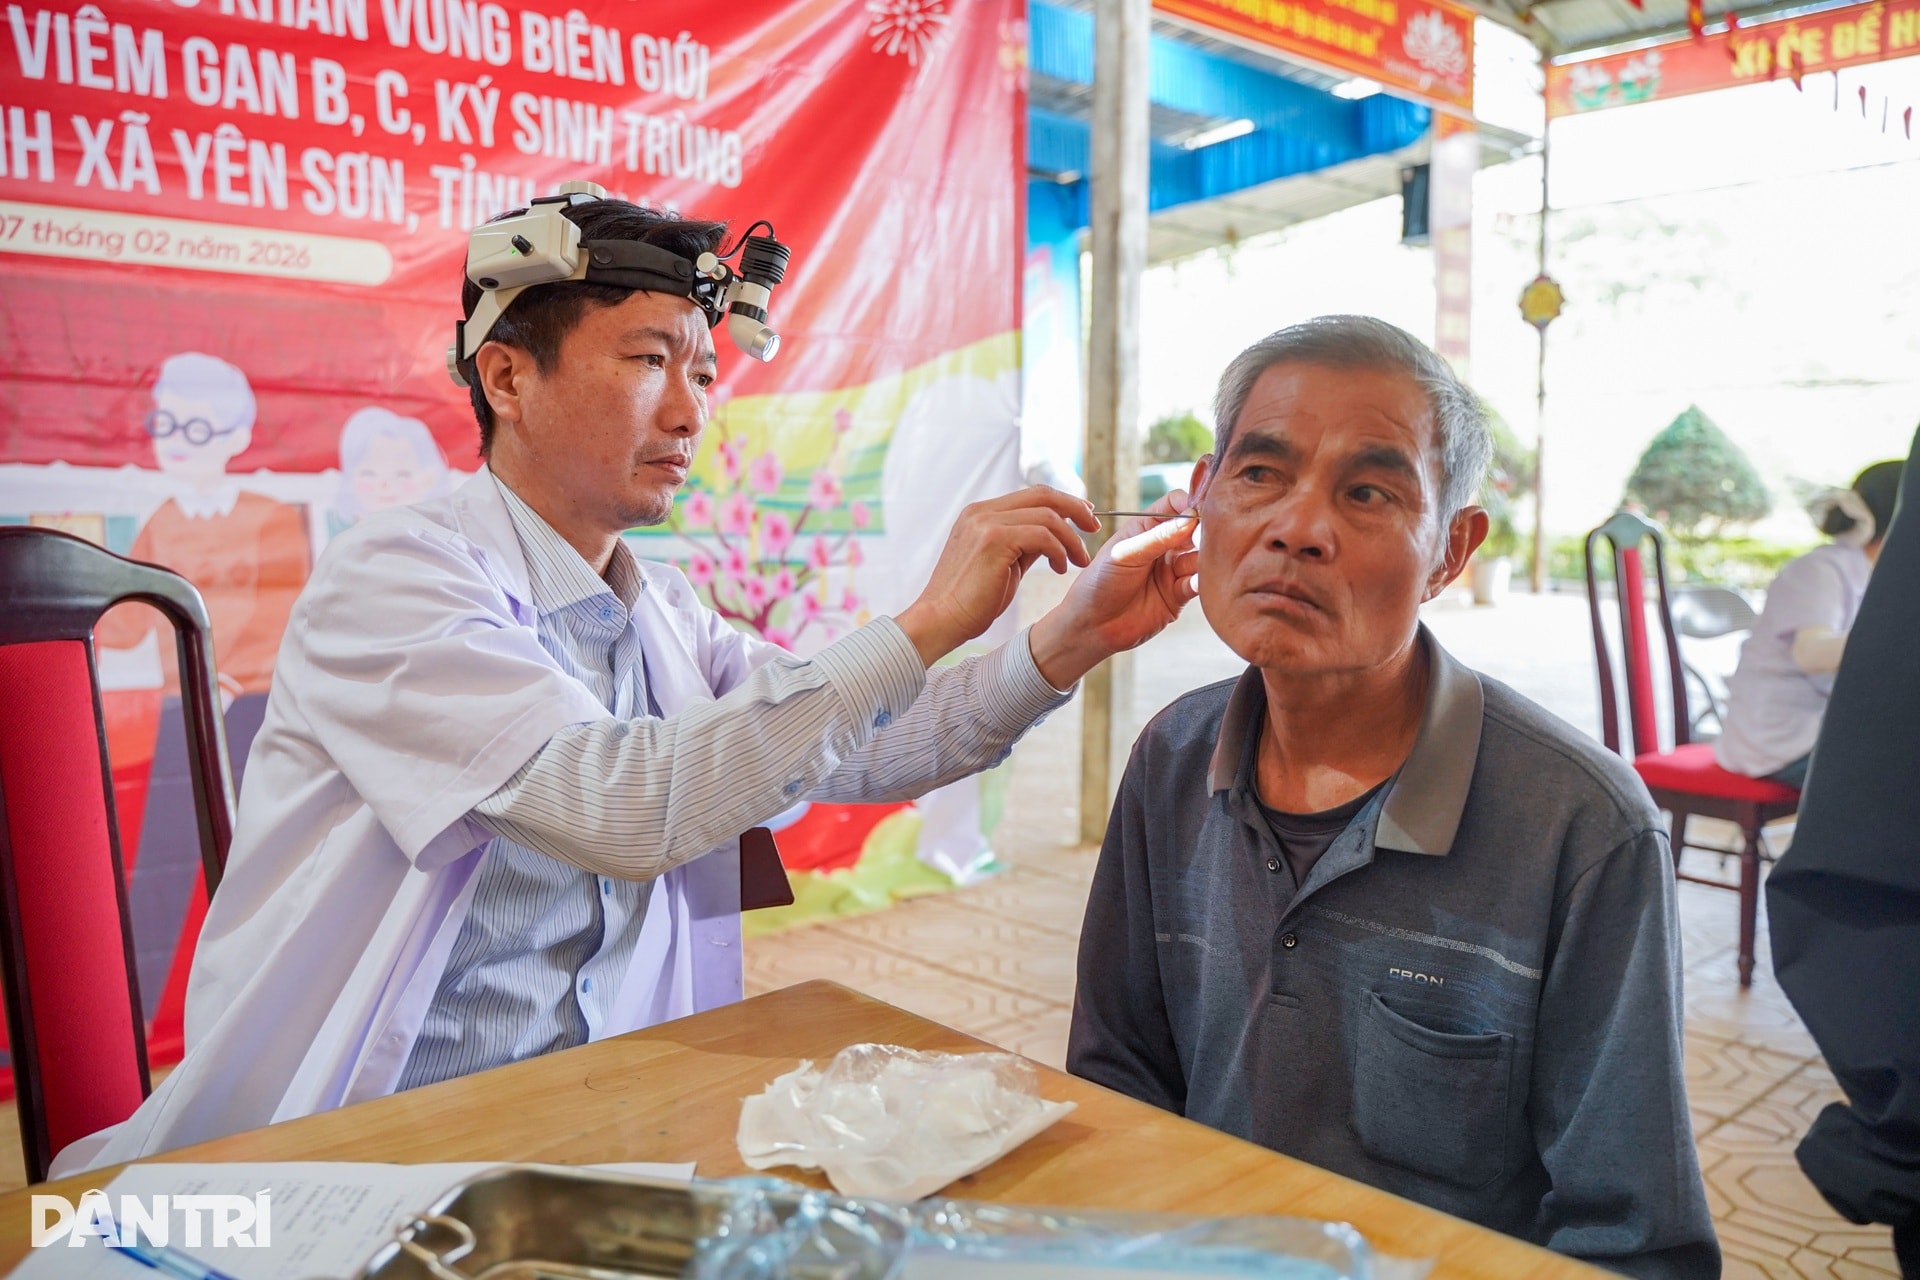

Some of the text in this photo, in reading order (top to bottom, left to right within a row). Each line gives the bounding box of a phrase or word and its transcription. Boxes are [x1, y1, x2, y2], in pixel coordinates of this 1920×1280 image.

[5, 3, 743, 190] VIÊM GAN B, C, KÝ SINH TRÙNG
[519, 10, 626, 86] BIÊN
[630, 30, 711, 103] GIỚI
[0, 104, 55, 183] H
[70, 109, 162, 196] XÃ
[170, 122, 288, 211] YÊN
[301, 147, 420, 235] SƠN,
[32, 218, 125, 257] tháng
[133, 228, 171, 256] 02
[176, 234, 241, 263] năm
[246, 239, 312, 270] 2026
